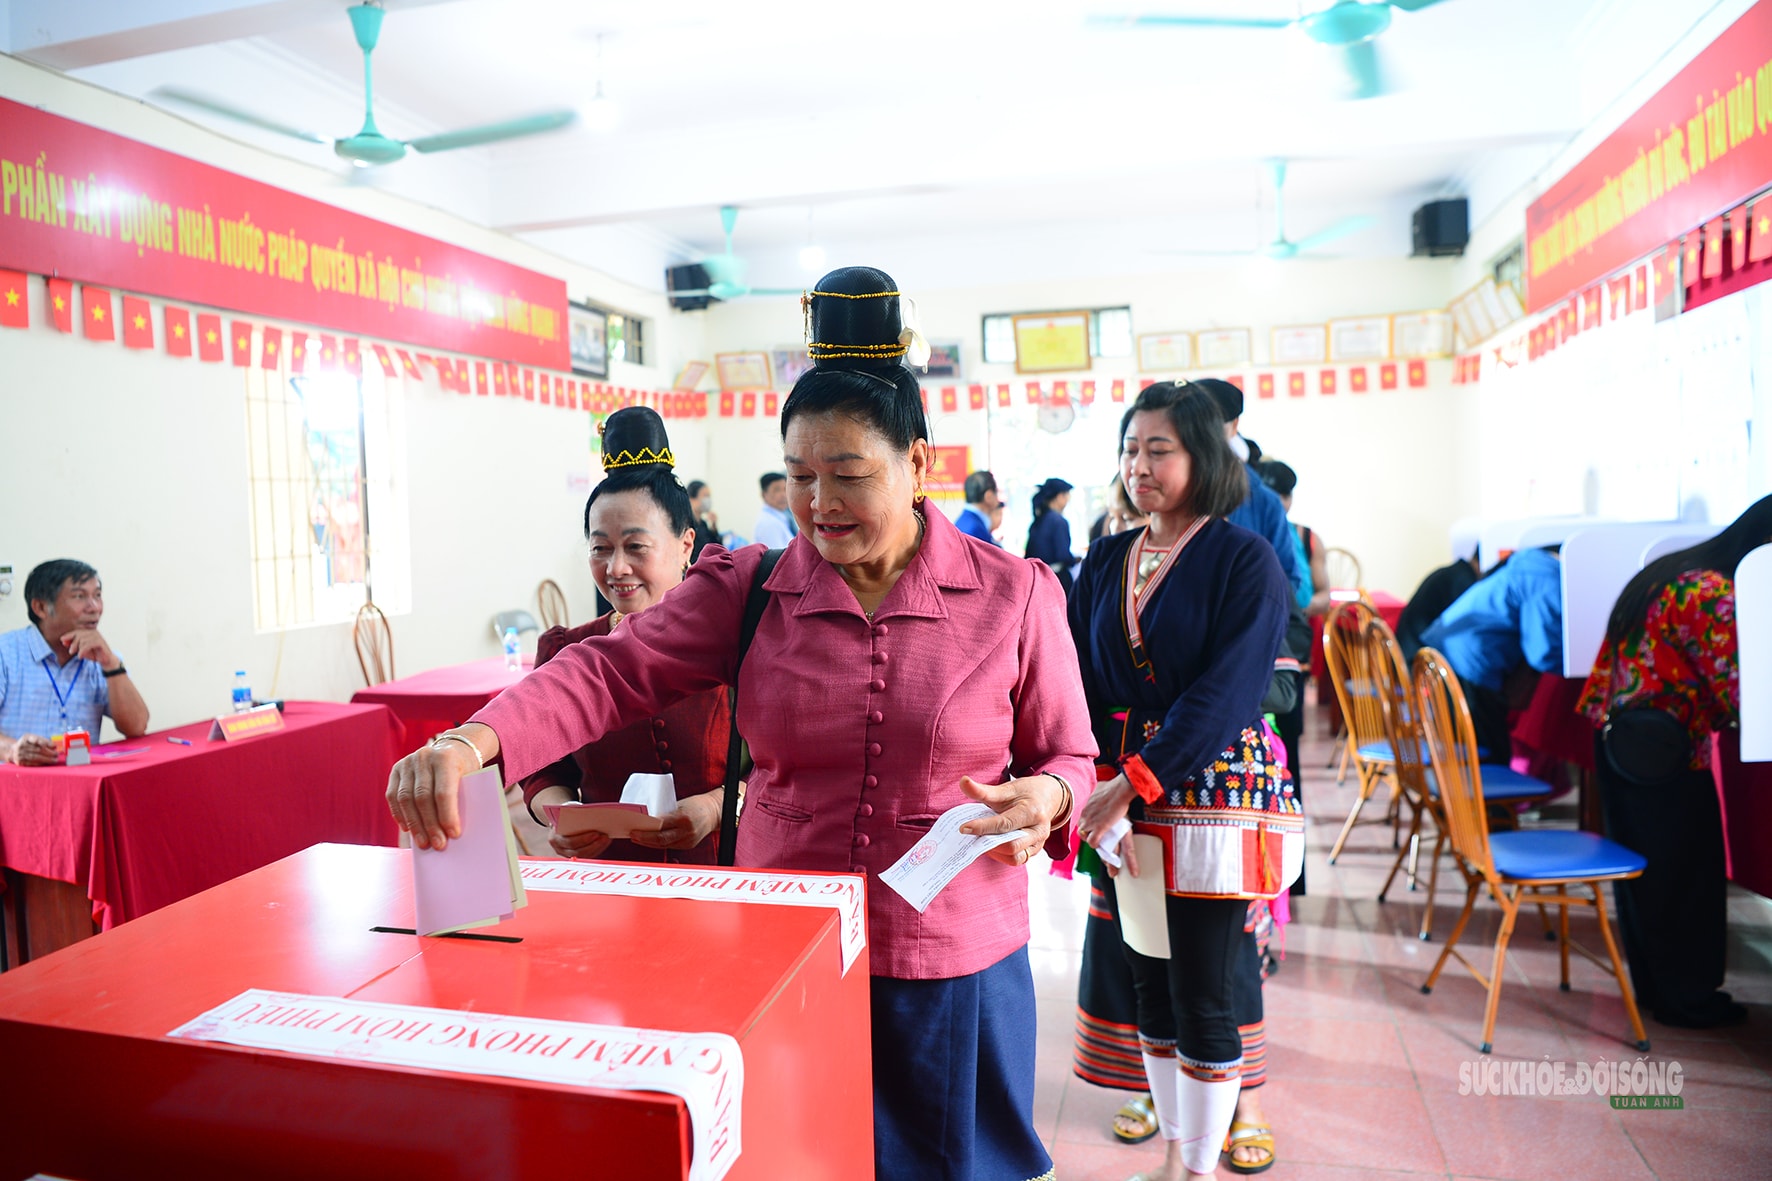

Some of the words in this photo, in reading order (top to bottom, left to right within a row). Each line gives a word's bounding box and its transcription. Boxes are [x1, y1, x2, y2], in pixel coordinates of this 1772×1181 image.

[1, 151, 67, 228] PHẦN
[71, 172, 112, 239] XÂY
[177, 203, 216, 262] NHÀ
[219, 212, 265, 274] NƯỚC
[267, 228, 308, 283] PHÁP
[555, 869, 627, 885] HÒM
[626, 873, 732, 890] PHONG
[735, 879, 816, 896] NIÊM
[219, 1002, 340, 1031] PHIẾU
[333, 1014, 433, 1044] HÒM
[428, 1022, 572, 1058] PHONG
[573, 1038, 688, 1072] NIÊM
